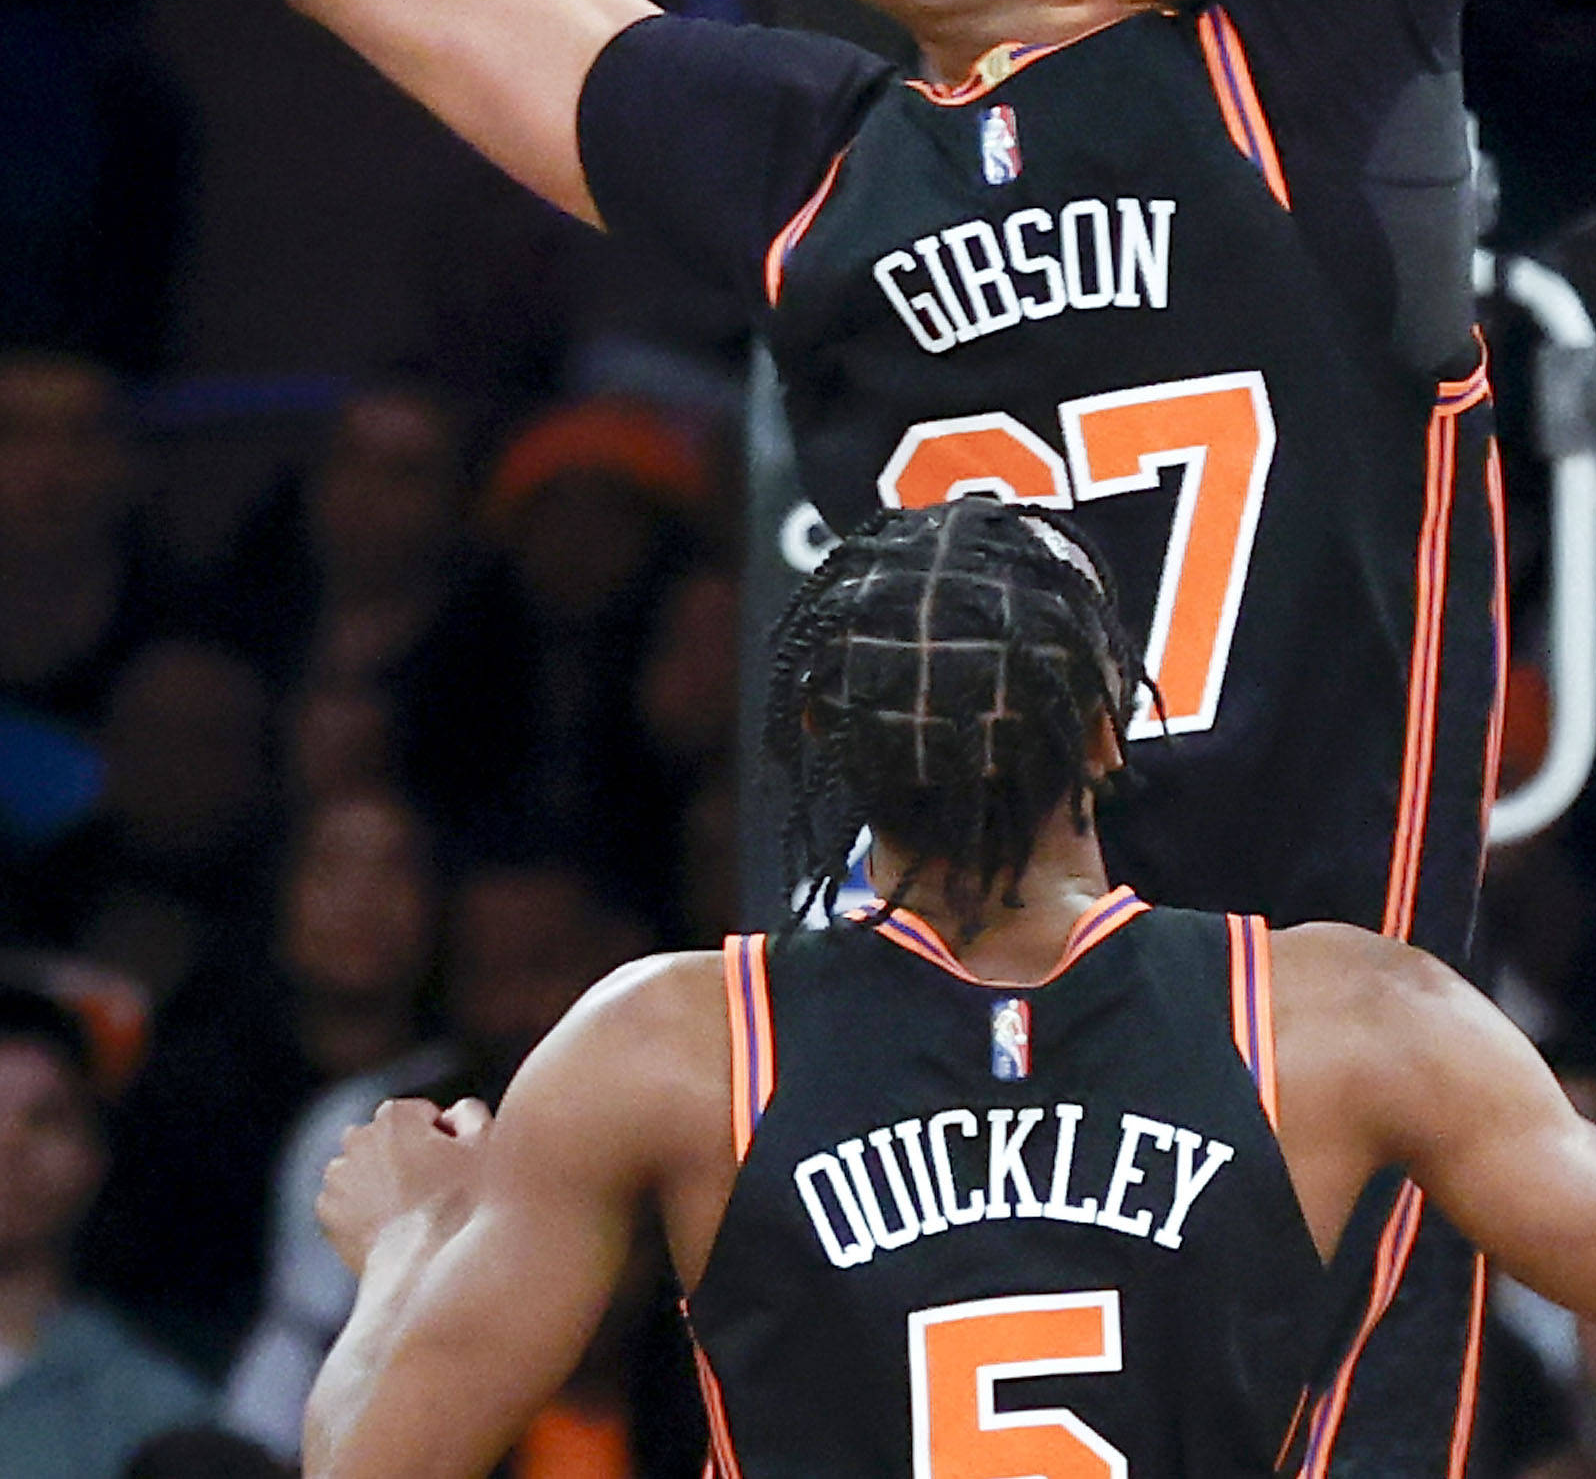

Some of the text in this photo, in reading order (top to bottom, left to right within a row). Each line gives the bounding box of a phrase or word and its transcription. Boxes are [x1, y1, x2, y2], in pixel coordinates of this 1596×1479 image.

[873, 198, 1176, 354] GIBSON
[794, 1103, 1235, 1270] QUICKLEY
[908, 1289, 1129, 1479] 5
